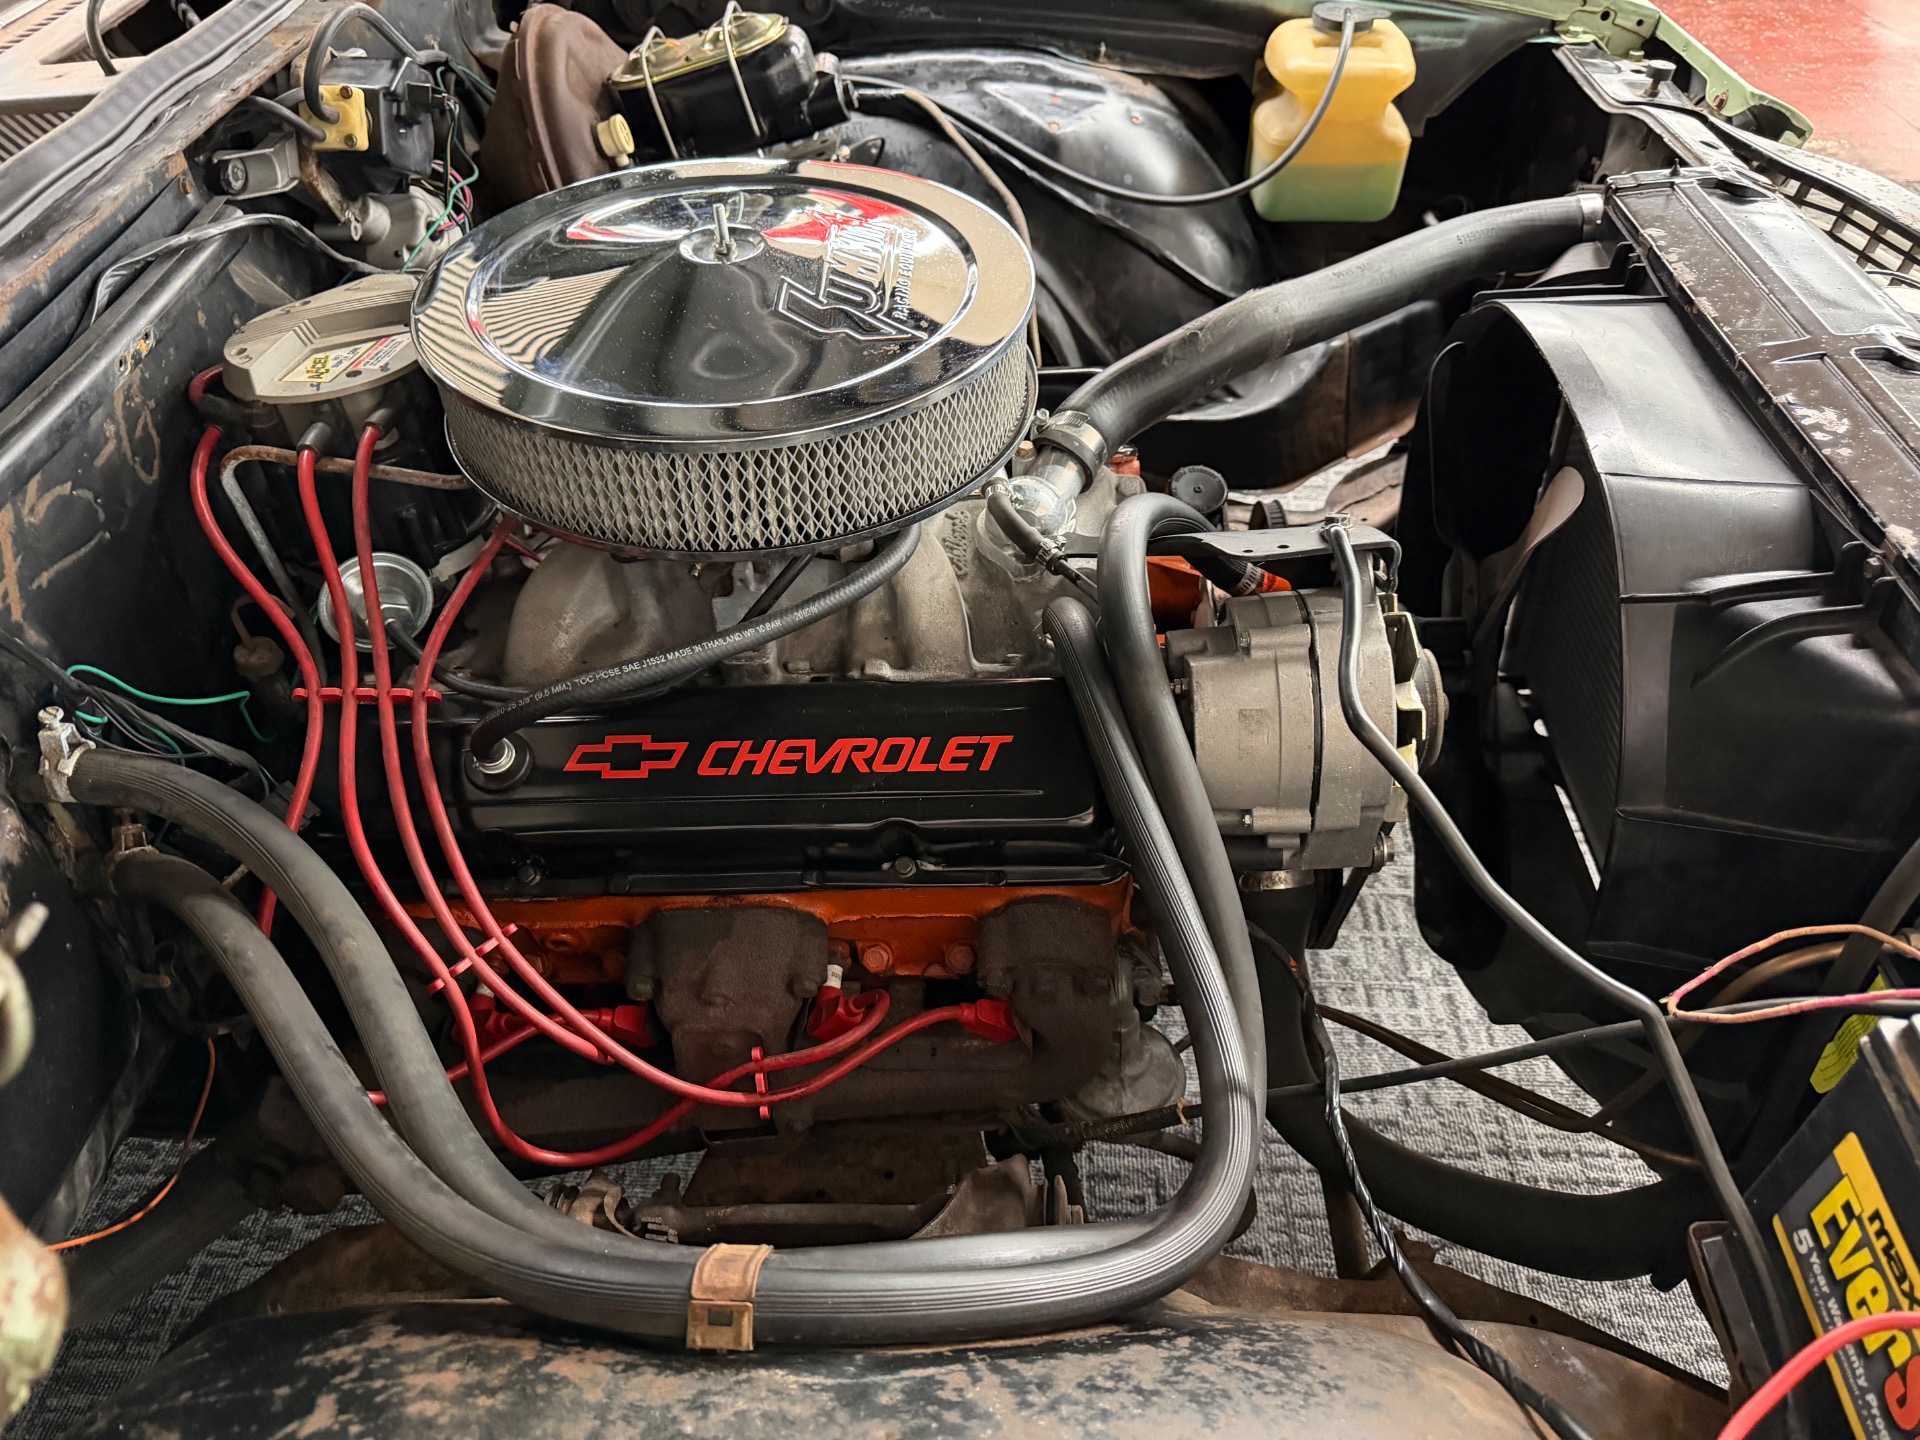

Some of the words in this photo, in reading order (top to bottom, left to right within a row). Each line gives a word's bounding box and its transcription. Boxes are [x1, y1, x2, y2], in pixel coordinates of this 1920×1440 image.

[597, 667, 621, 681] HOSE
[622, 660, 641, 674] SAE
[642, 654, 667, 668] J1532
[667, 646, 693, 660] MADE
[693, 644, 702, 655] IN
[702, 631, 743, 651] THAILAND
[742, 626, 756, 638] WP
[756, 623, 766, 635] 10
[765, 618, 782, 632] BAR
[697, 735, 1014, 776] CHEVROLET
[1793, 1228, 1815, 1254] 5
[1809, 1251, 1831, 1295] Year
[1826, 1297, 1868, 1389] Waanty
[1811, 1174, 1920, 1440] EverS
